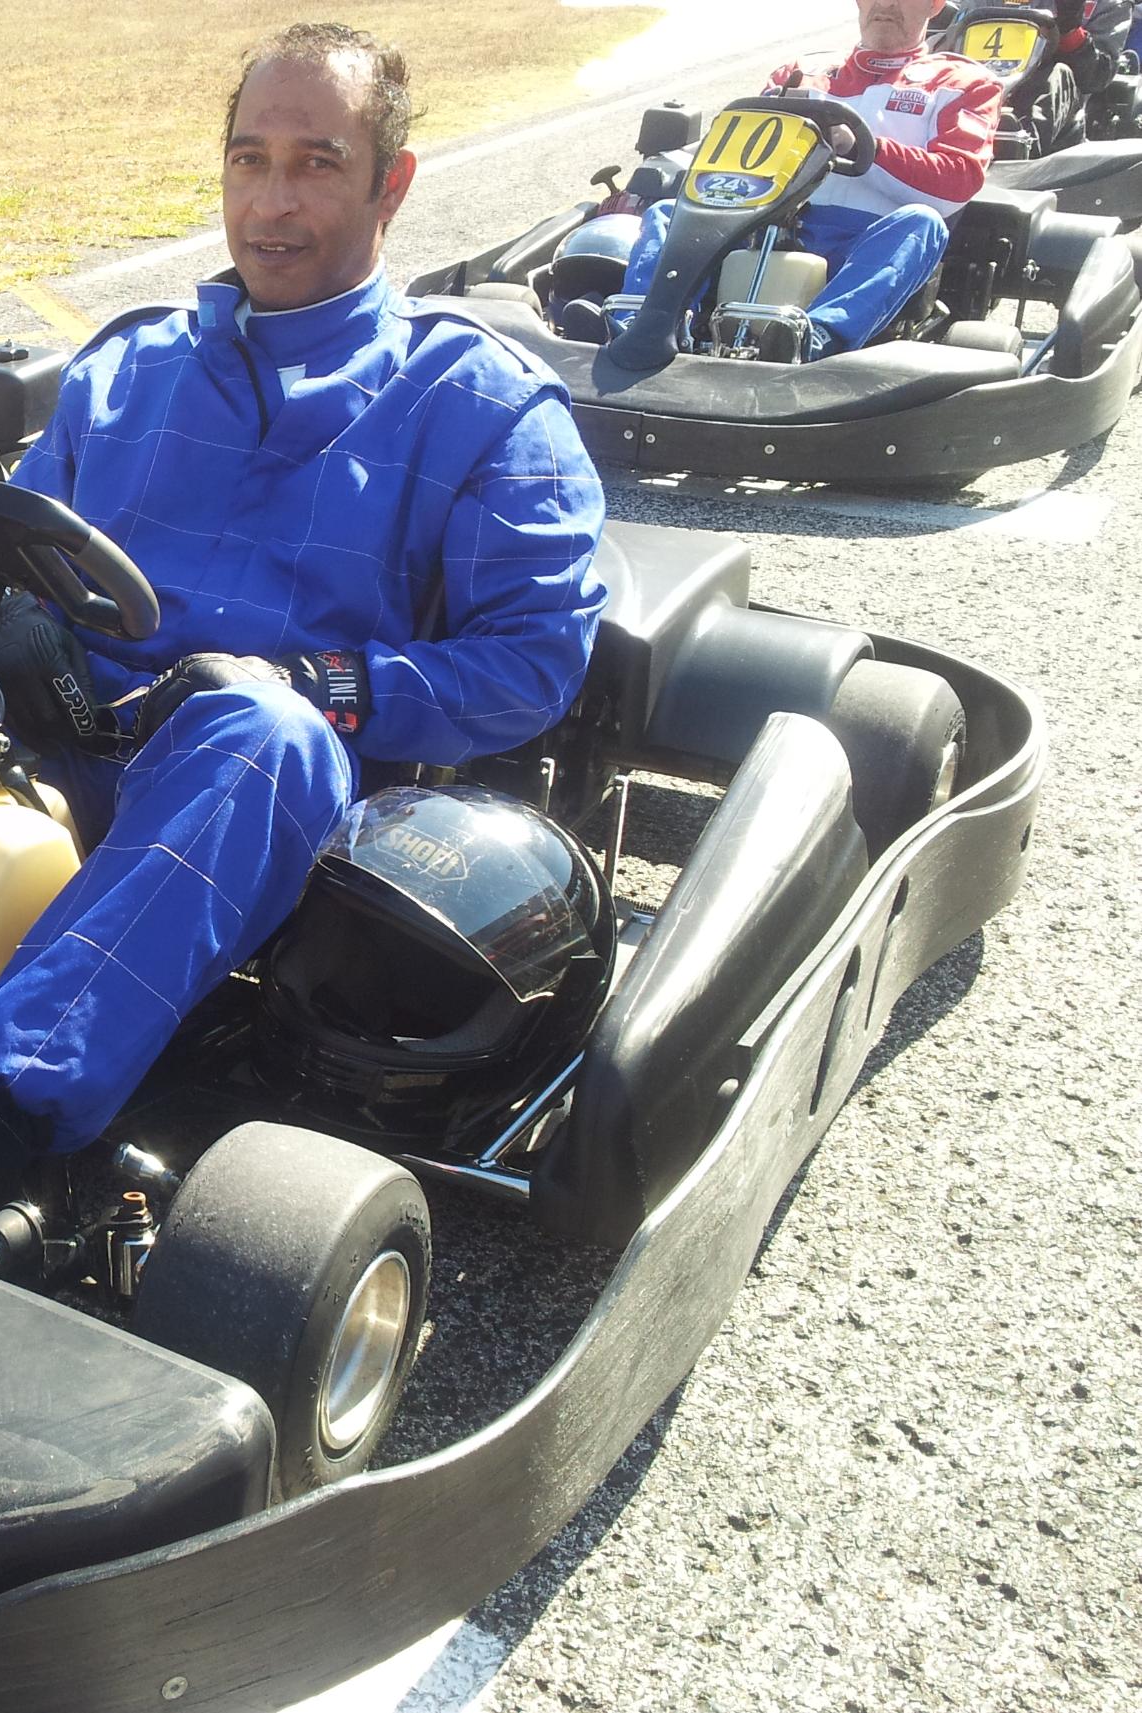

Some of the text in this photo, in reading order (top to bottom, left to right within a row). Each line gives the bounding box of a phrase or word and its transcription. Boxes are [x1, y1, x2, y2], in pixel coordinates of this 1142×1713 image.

[983, 27, 1004, 58] 4
[708, 116, 784, 171] 10
[709, 177, 739, 191] 24
[326, 668, 358, 705] LINE
[381, 827, 460, 877] SHOEI
